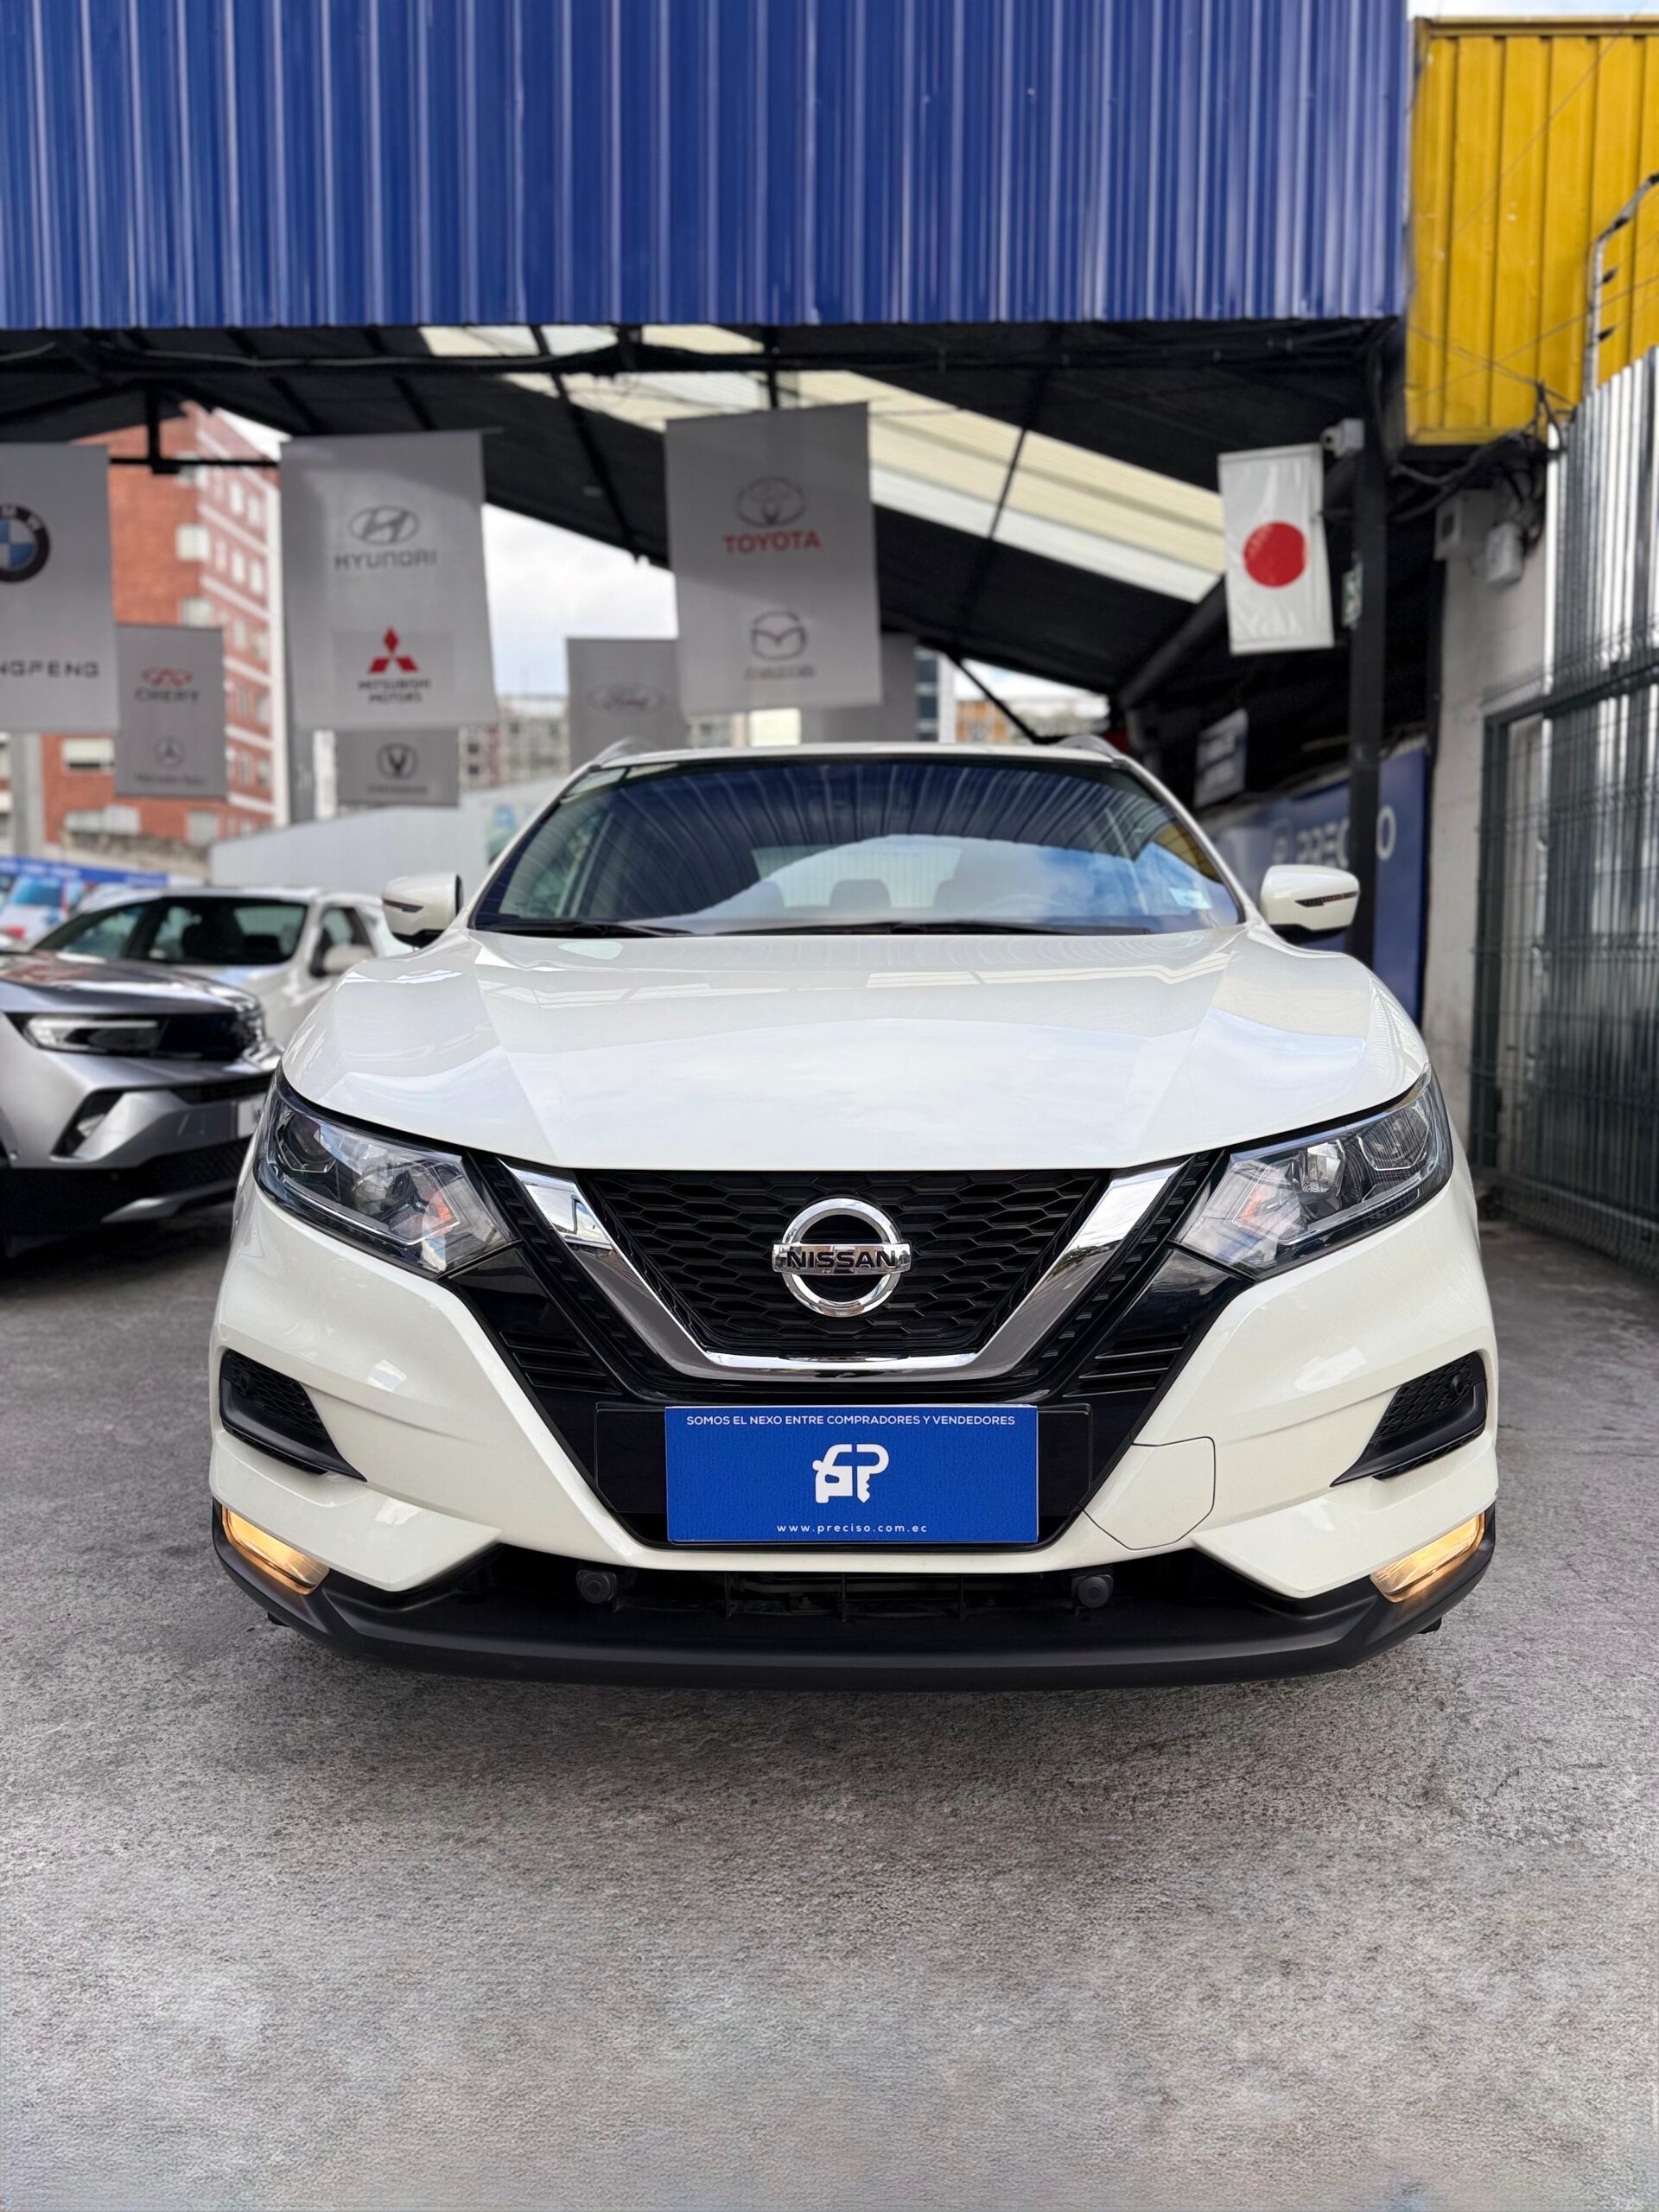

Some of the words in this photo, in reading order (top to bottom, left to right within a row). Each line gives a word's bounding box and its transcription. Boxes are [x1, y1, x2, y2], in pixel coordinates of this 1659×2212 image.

[722, 529, 823, 554] TOYOTA
[334, 549, 438, 570] HYUNDAI
[786, 1250, 897, 1268] NISSAN
[686, 1415, 730, 1426] SOMOS
[733, 1416, 747, 1425] EL
[750, 1415, 783, 1425] NEXO
[785, 1415, 824, 1425] ENTRE
[826, 1415, 920, 1425] COMPRADORES
[923, 1415, 931, 1425] Y
[932, 1415, 1015, 1426] VENDEDORES
[777, 1522, 927, 1535] www.preciso.com.ec
